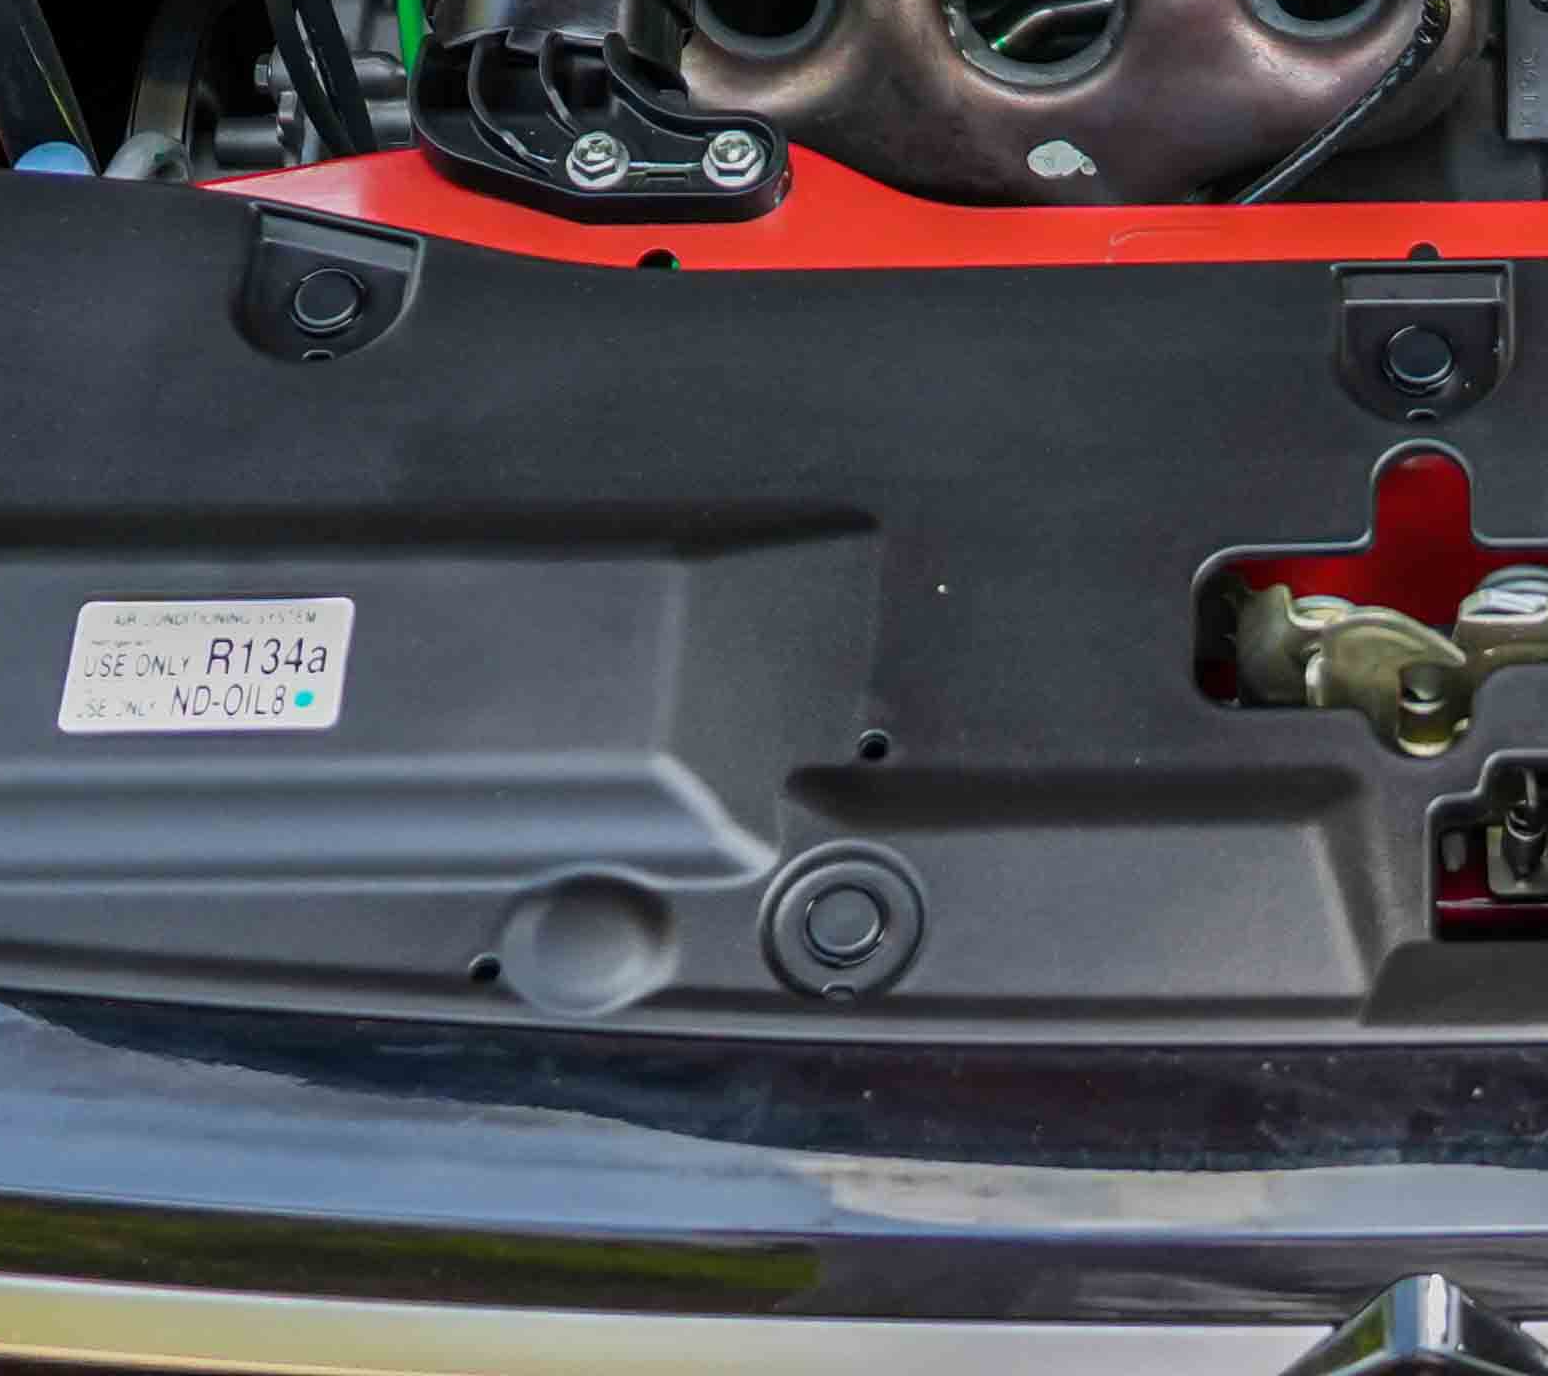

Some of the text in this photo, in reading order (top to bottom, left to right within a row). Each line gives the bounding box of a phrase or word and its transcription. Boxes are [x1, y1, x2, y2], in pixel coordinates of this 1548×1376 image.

[83, 636, 329, 678] USE ONLY R134a
[76, 697, 108, 718] SE
[169, 684, 288, 717] ND-OIL8
